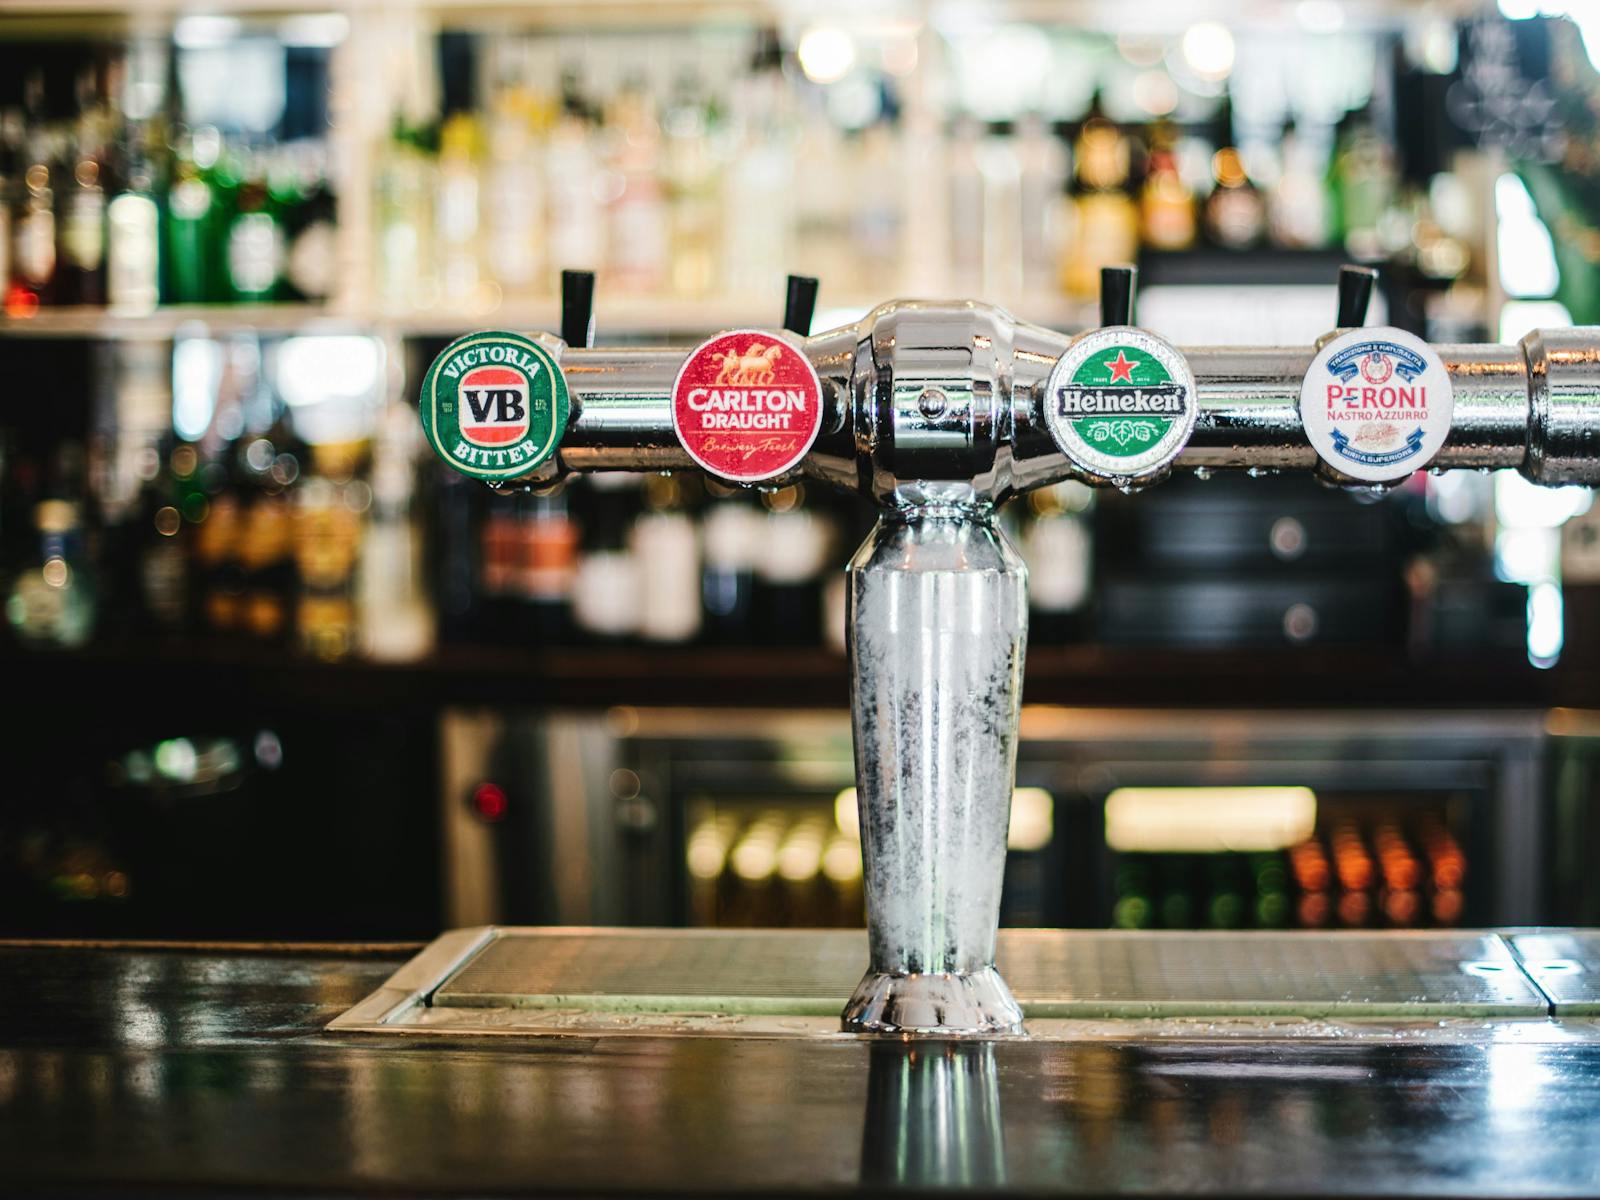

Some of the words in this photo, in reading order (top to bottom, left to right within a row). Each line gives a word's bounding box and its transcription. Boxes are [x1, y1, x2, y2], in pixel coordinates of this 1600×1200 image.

[443, 346, 541, 379] VICTORIA
[463, 389, 525, 423] VB
[687, 388, 806, 412] CARLTON
[1063, 389, 1182, 412] Heineken
[1327, 384, 1427, 409] PERONI
[701, 413, 792, 429] DRAUGHT
[1327, 410, 1372, 421] NASTRO
[1374, 410, 1428, 421] AZZURRO
[453, 439, 539, 466] BITTER
[759, 437, 797, 451] Fresh
